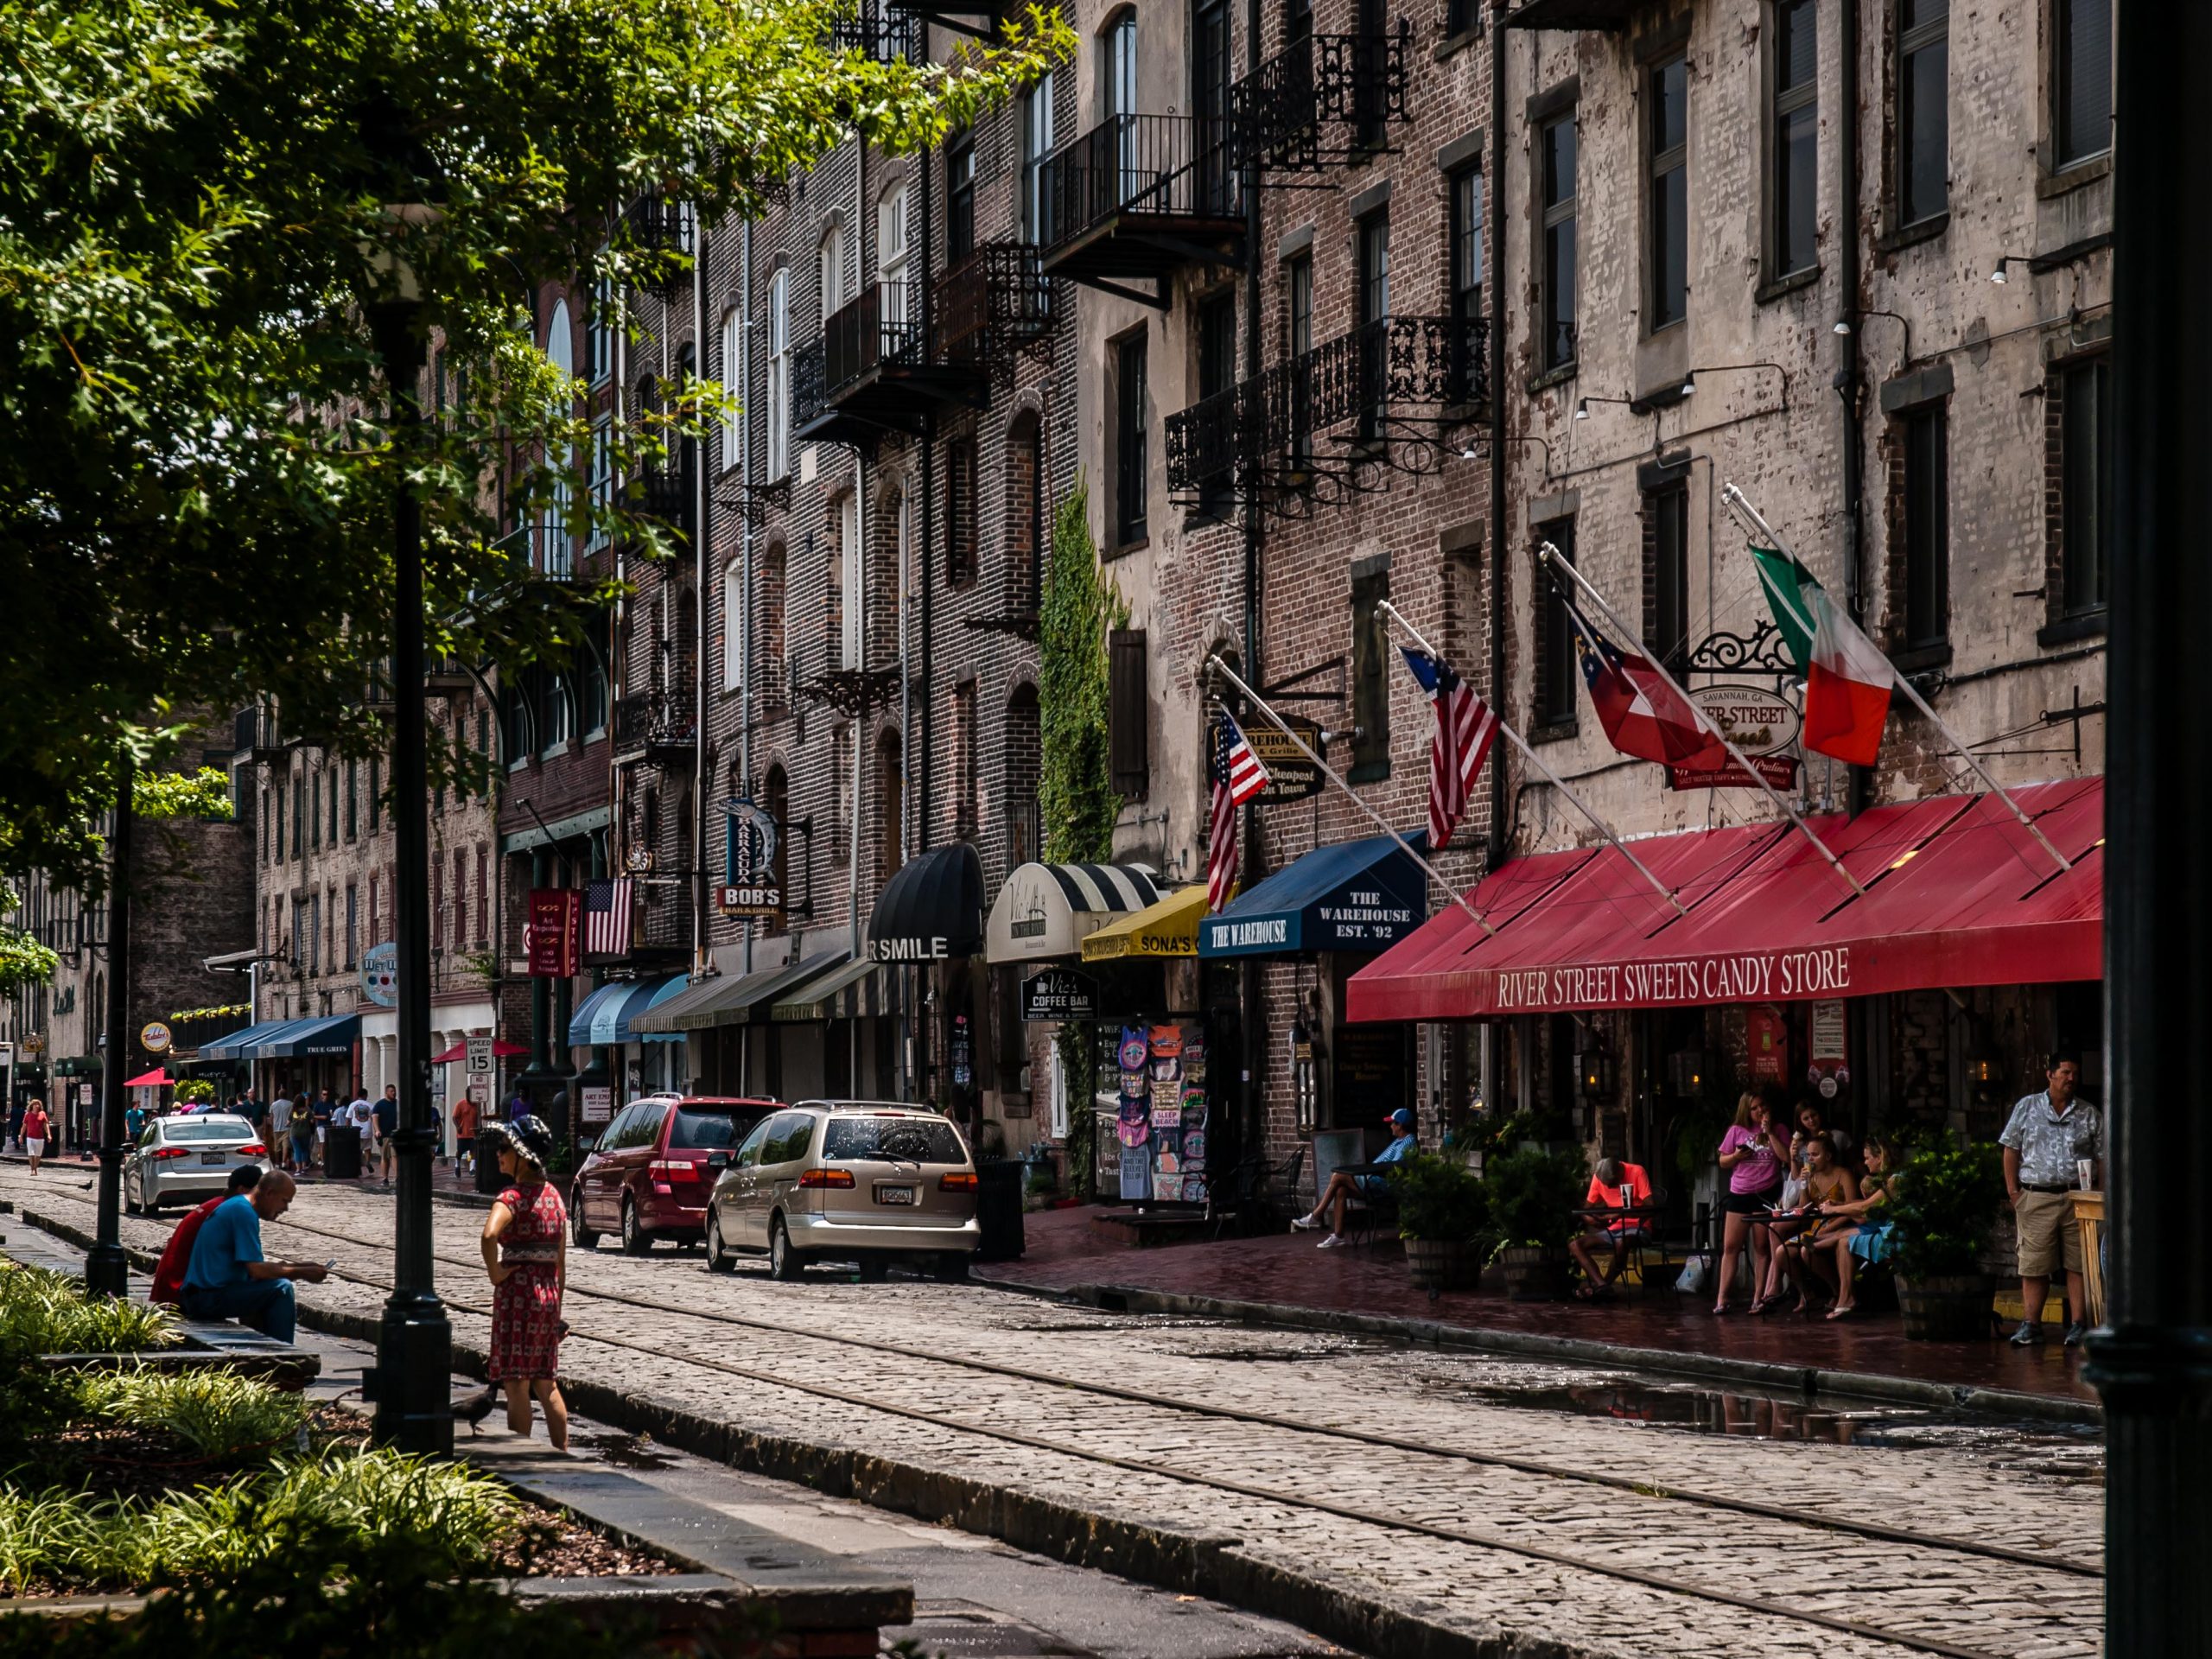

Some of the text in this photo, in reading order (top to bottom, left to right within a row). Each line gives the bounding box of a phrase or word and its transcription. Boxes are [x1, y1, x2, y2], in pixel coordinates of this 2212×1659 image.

[1702, 692, 1764, 703] SAVANNAH, GA
[1730, 706, 1788, 724] STREET
[1269, 747, 1299, 756] Grille
[1267, 766, 1314, 782] Cheapest
[1277, 781, 1306, 795] Town
[737, 817, 751, 884] BARRACUDA
[725, 888, 780, 906] BOB'S
[1350, 892, 1381, 905] THE
[1319, 907, 1411, 922] WAREHOUSE
[532, 924, 564, 933] Emporium
[569, 896, 578, 974] UPSTAIRS
[1211, 925, 1230, 949] THE
[1230, 919, 1287, 947] WAREHOUSE
[1336, 924, 1394, 938] EST. '92
[880, 937, 949, 960] SMILE
[1141, 936, 1191, 951] SONA'S
[1046, 973, 1078, 994] Vic's
[1497, 946, 1850, 1008] RIVER STREET SWEETS CANDY STORE
[1033, 995, 1089, 1007] COFFEE BAR
[471, 1056, 488, 1070] 15
[1104, 1153, 1115, 1161] Ice
